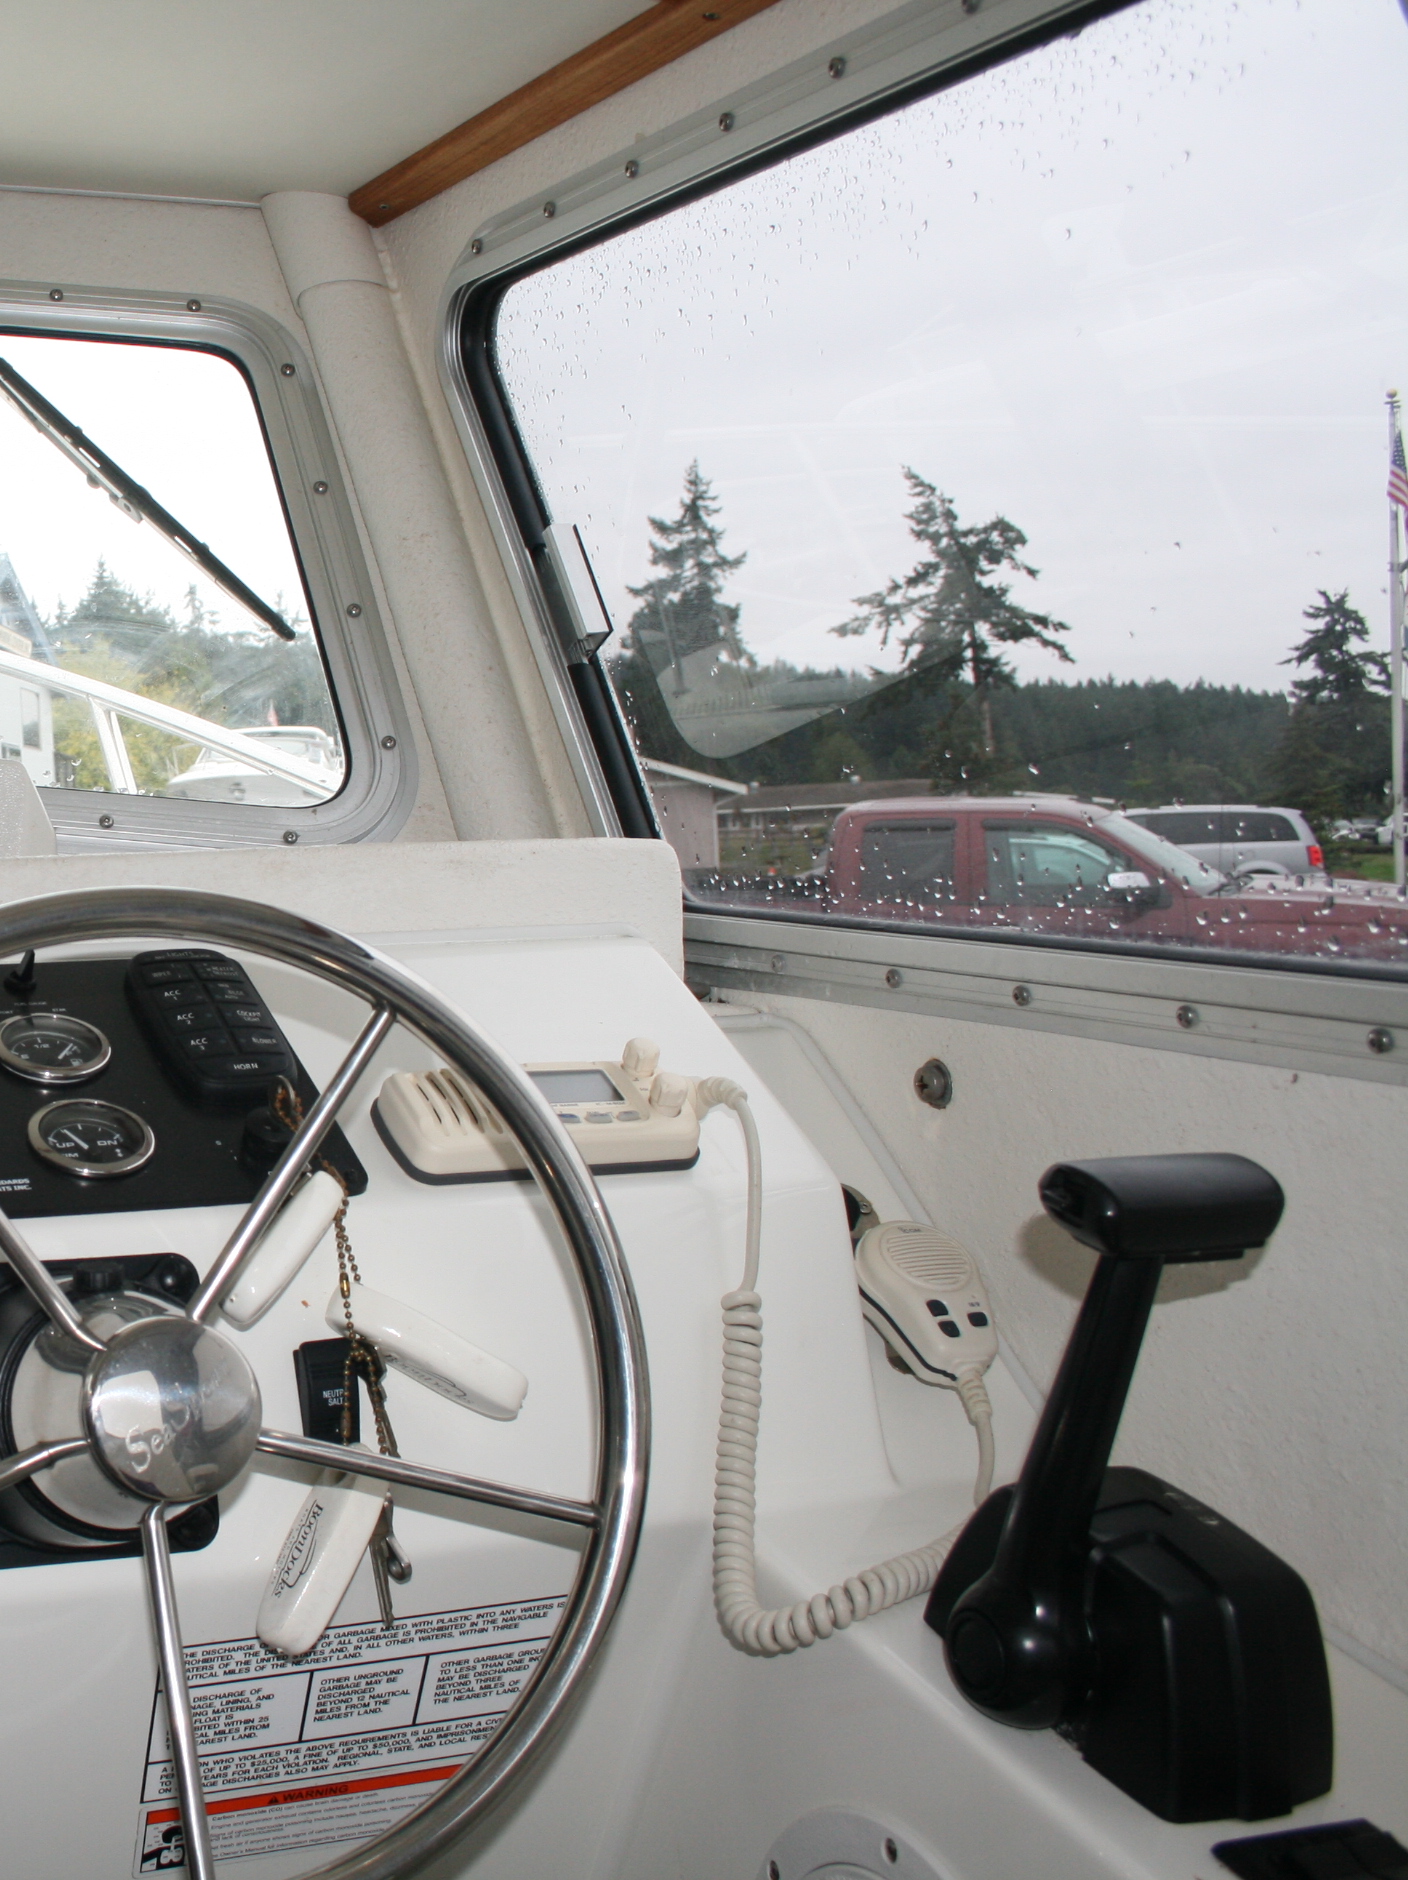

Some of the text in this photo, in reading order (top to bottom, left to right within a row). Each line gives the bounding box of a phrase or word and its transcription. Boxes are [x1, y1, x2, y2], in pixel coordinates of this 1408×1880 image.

[164, 989, 182, 998] ACC
[177, 1012, 195, 1022] ACC
[190, 1037, 209, 1046] ACC
[233, 1062, 260, 1071] HORN
[55, 1140, 76, 1149] UP
[274, 1503, 324, 1598] BoonDocks
[320, 1611, 548, 1648] OF ALL GARBAGE IS PROHIBITED IN THE NAVIGABLE
[333, 1627, 376, 1639] GARBAGE
[379, 1623, 407, 1633] MIXED
[410, 1619, 433, 1628] WITH
[435, 1614, 472, 1625] PLASTIC
[475, 1611, 496, 1619] INTO
[498, 1608, 516, 1616] ANY
[519, 1603, 554, 1613] WATERS
[217, 1662, 230, 1670] OF
[234, 1659, 252, 1667] THE
[255, 1653, 289, 1664] UNITED
[328, 1645, 350, 1654] AND,
[352, 1643, 362, 1651] IN
[365, 1641, 382, 1649] ALL
[384, 1636, 414, 1647] OTHER
[417, 1631, 455, 1642] WATERS,
[458, 1626, 488, 1636] WITHIN
[491, 1622, 519, 1632] THREE
[222, 1650, 363, 1676] MILES OF THE NEAREST LAND.
[320, 1667, 404, 1685] OTHER UNGROUND
[435, 1674, 502, 1690] BEYOND THREE
[436, 1664, 529, 1683] MAY BE DISCHARGED
[316, 1686, 375, 1700] DISCHARGED
[318, 1675, 397, 1693] GARBAGE MAY BE
[316, 1688, 411, 1708] BEYOND 12 NAUTICAL
[432, 1686, 521, 1705] THE NEAREST LAND.
[312, 1706, 383, 1722] NEAREST LAND.
[314, 1698, 390, 1715] MILES FROM THE
[212, 1756, 235, 1766] WHO
[237, 1750, 281, 1762] VIOLATES
[284, 1746, 301, 1755] THE
[305, 1741, 335, 1752] ABOVE
[338, 1731, 407, 1747] REQUIREMENTS
[422, 1724, 451, 1735] LIABLE
[454, 1721, 473, 1730] FOR
[221, 1758, 360, 1785] DISCHARGES ALSO MAY APPLY.
[282, 1785, 349, 1804] WARNING
